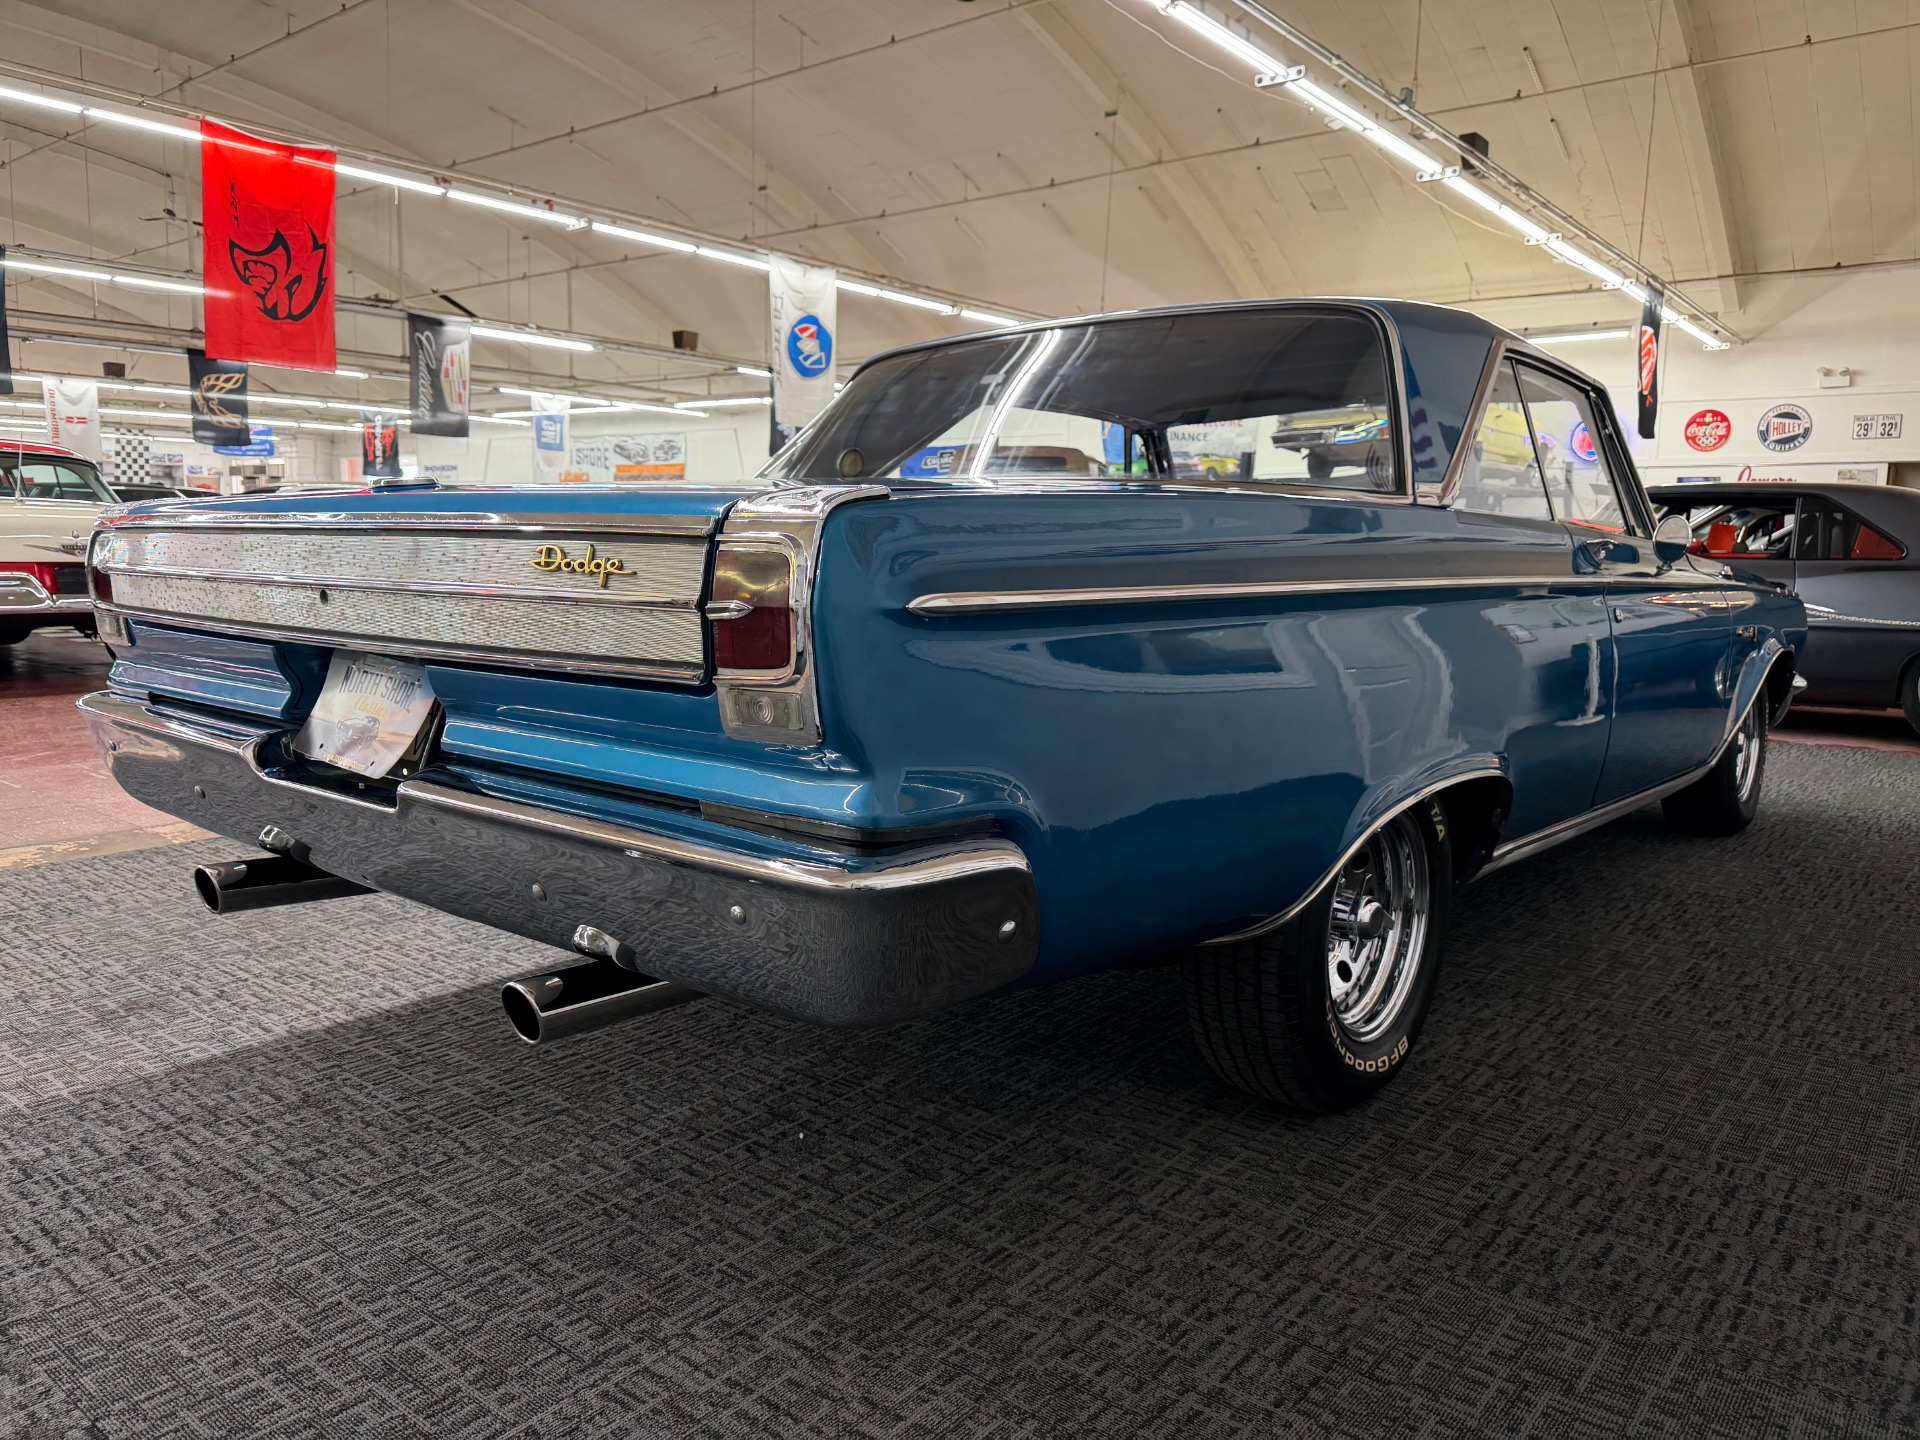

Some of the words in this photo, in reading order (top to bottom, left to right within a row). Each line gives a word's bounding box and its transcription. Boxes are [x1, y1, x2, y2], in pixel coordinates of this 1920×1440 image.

[1170, 431, 1209, 442] INANCE
[1772, 421, 1802, 437] HOLLEY
[529, 543, 637, 588] Dodge
[339, 665, 383, 695] NORTH
[381, 676, 423, 713] SHORE
[1325, 1000, 1409, 1072] BFGoodrich
